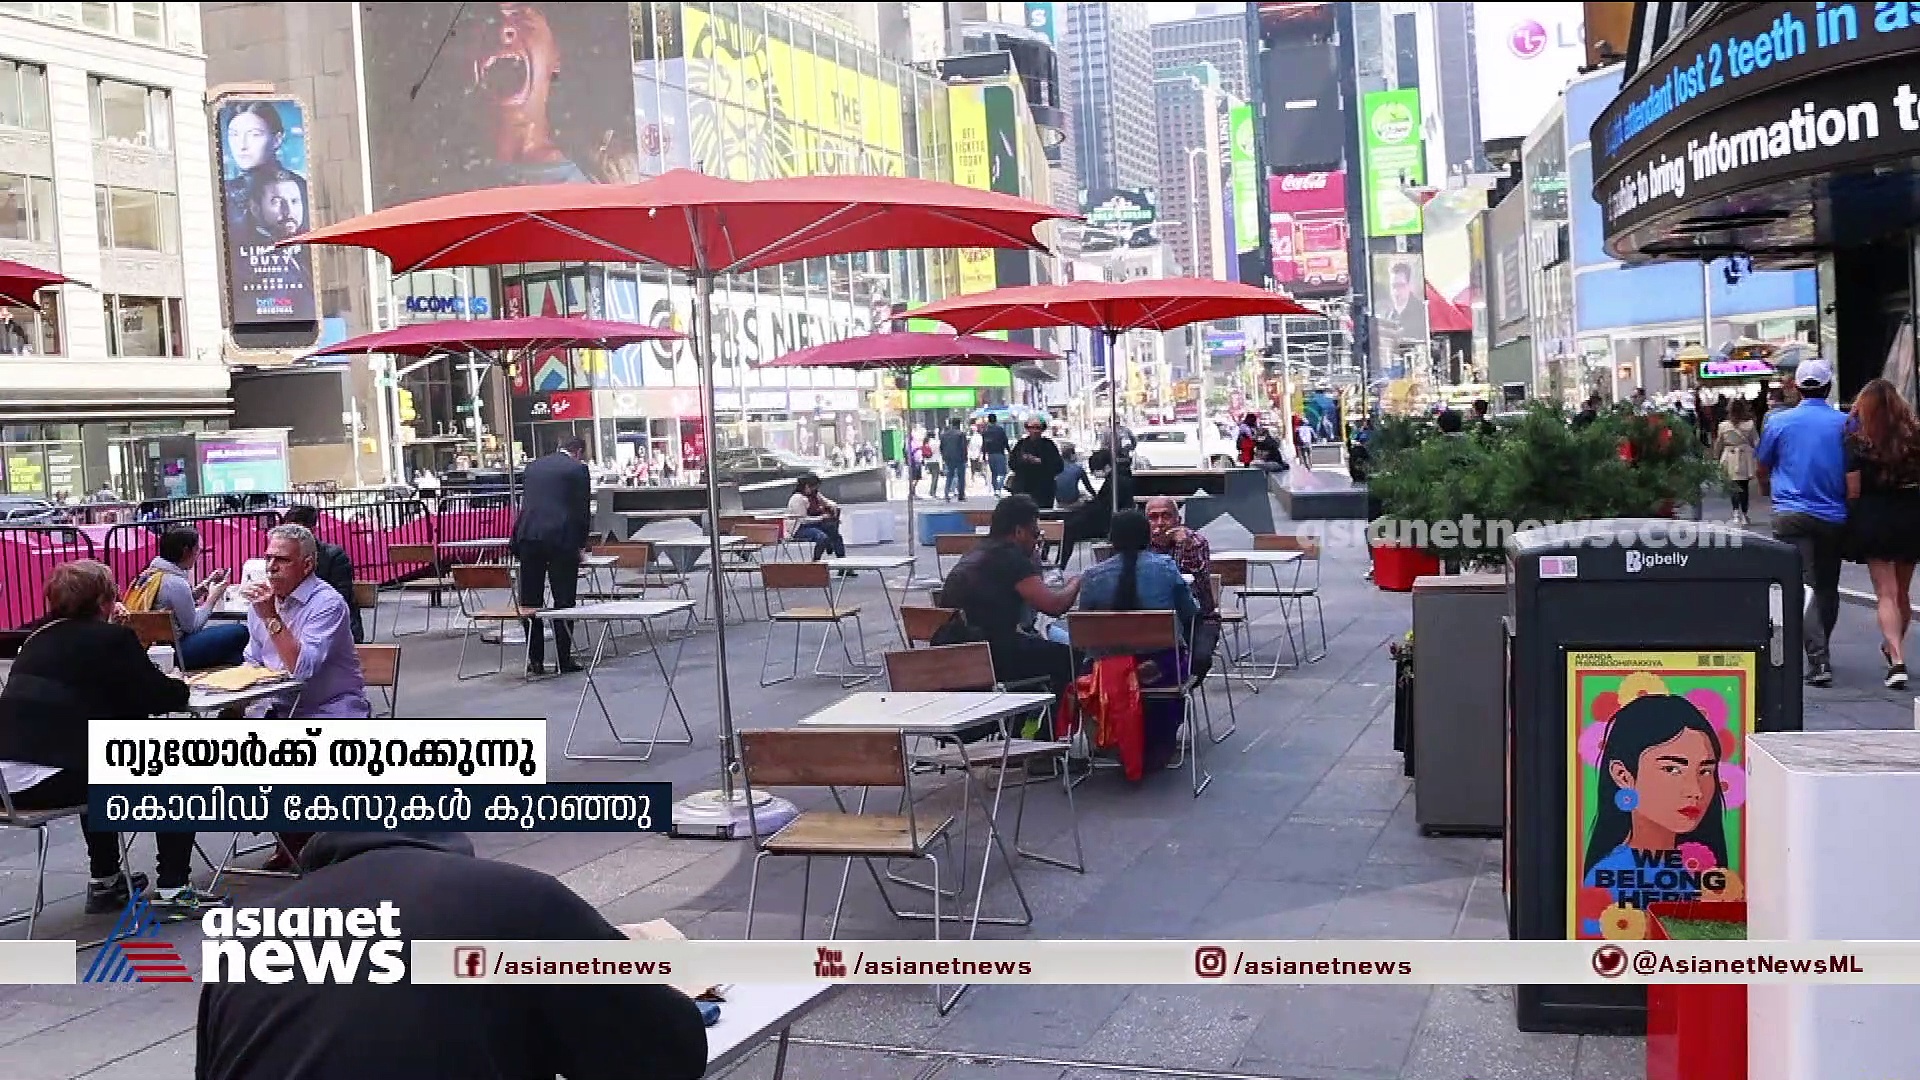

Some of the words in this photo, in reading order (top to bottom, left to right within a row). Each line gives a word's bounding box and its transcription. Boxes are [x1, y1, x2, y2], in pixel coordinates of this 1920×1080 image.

[1674, 54, 1705, 107] lost
[1709, 43, 1724, 88] 2
[1727, 11, 1806, 78] teeth
[1816, 2, 1858, 48] in
[831, 90, 861, 125] THE
[1637, 169, 1649, 205] to
[1650, 153, 1686, 199] bring
[1688, 102, 1879, 182] 'information
[1893, 84, 1920, 131] t
[250, 255, 291, 265] DUTY
[1630, 849, 1683, 868] WE
[1595, 869, 1726, 891] BELONG
